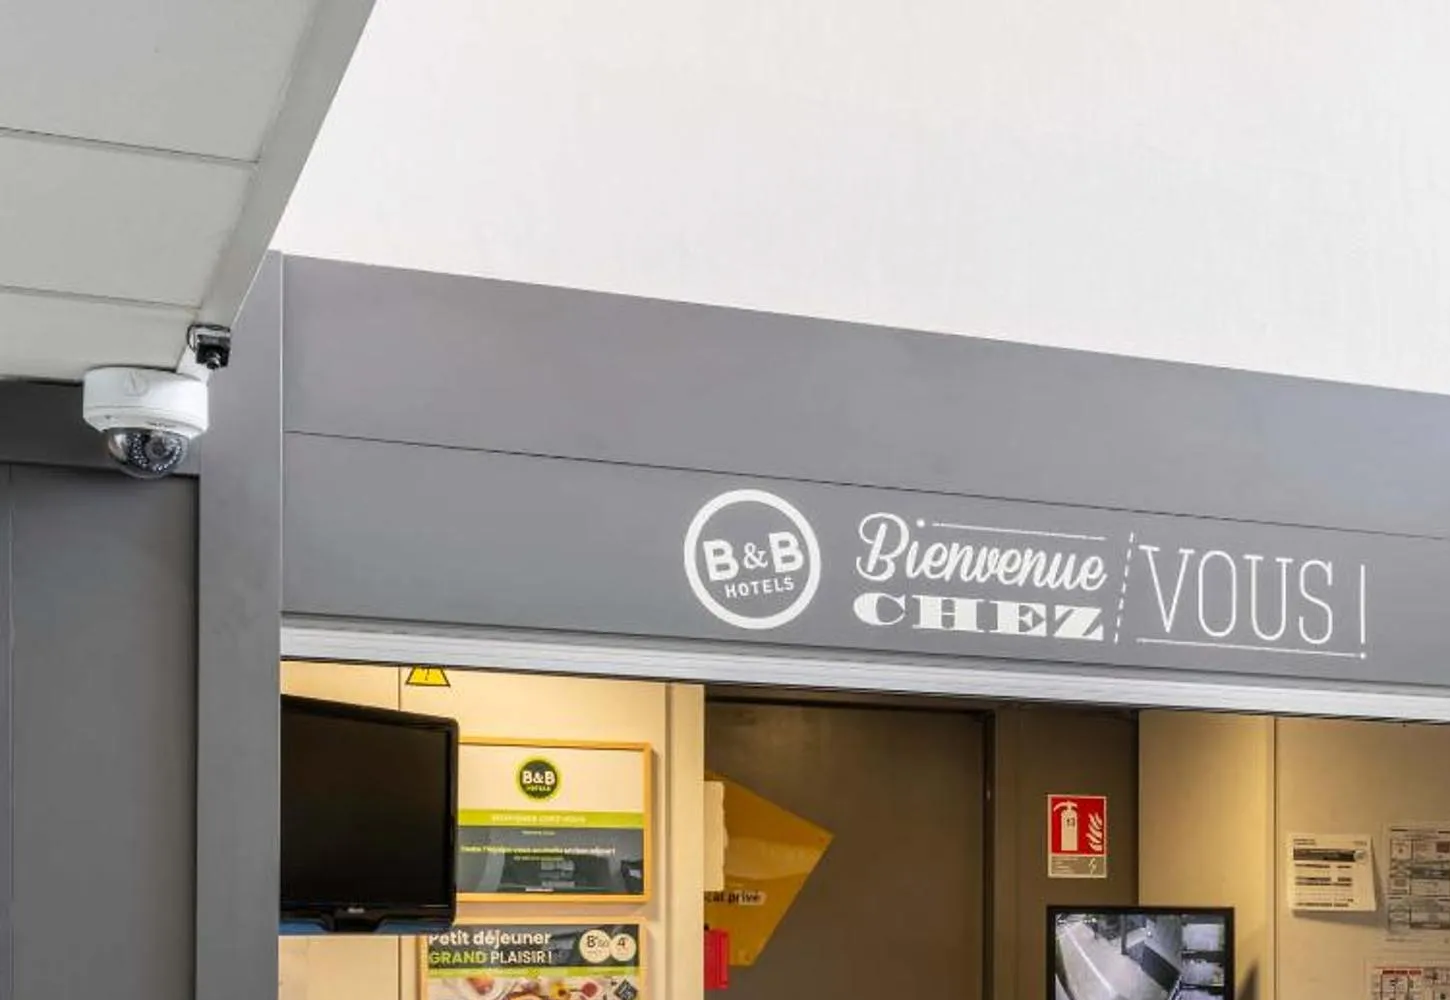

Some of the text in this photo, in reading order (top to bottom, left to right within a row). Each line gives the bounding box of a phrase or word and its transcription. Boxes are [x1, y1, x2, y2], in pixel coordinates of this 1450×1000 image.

[703, 529, 804, 583] B&B
[854, 511, 1107, 592] Bienvenue
[723, 575, 796, 599] HOTELS
[1137, 543, 1336, 645] VOUS
[852, 592, 1105, 641] CHEZ
[521, 770, 556, 786] B&B
[473, 929, 551, 949] déjeuner
[430, 950, 487, 965] GRAND
